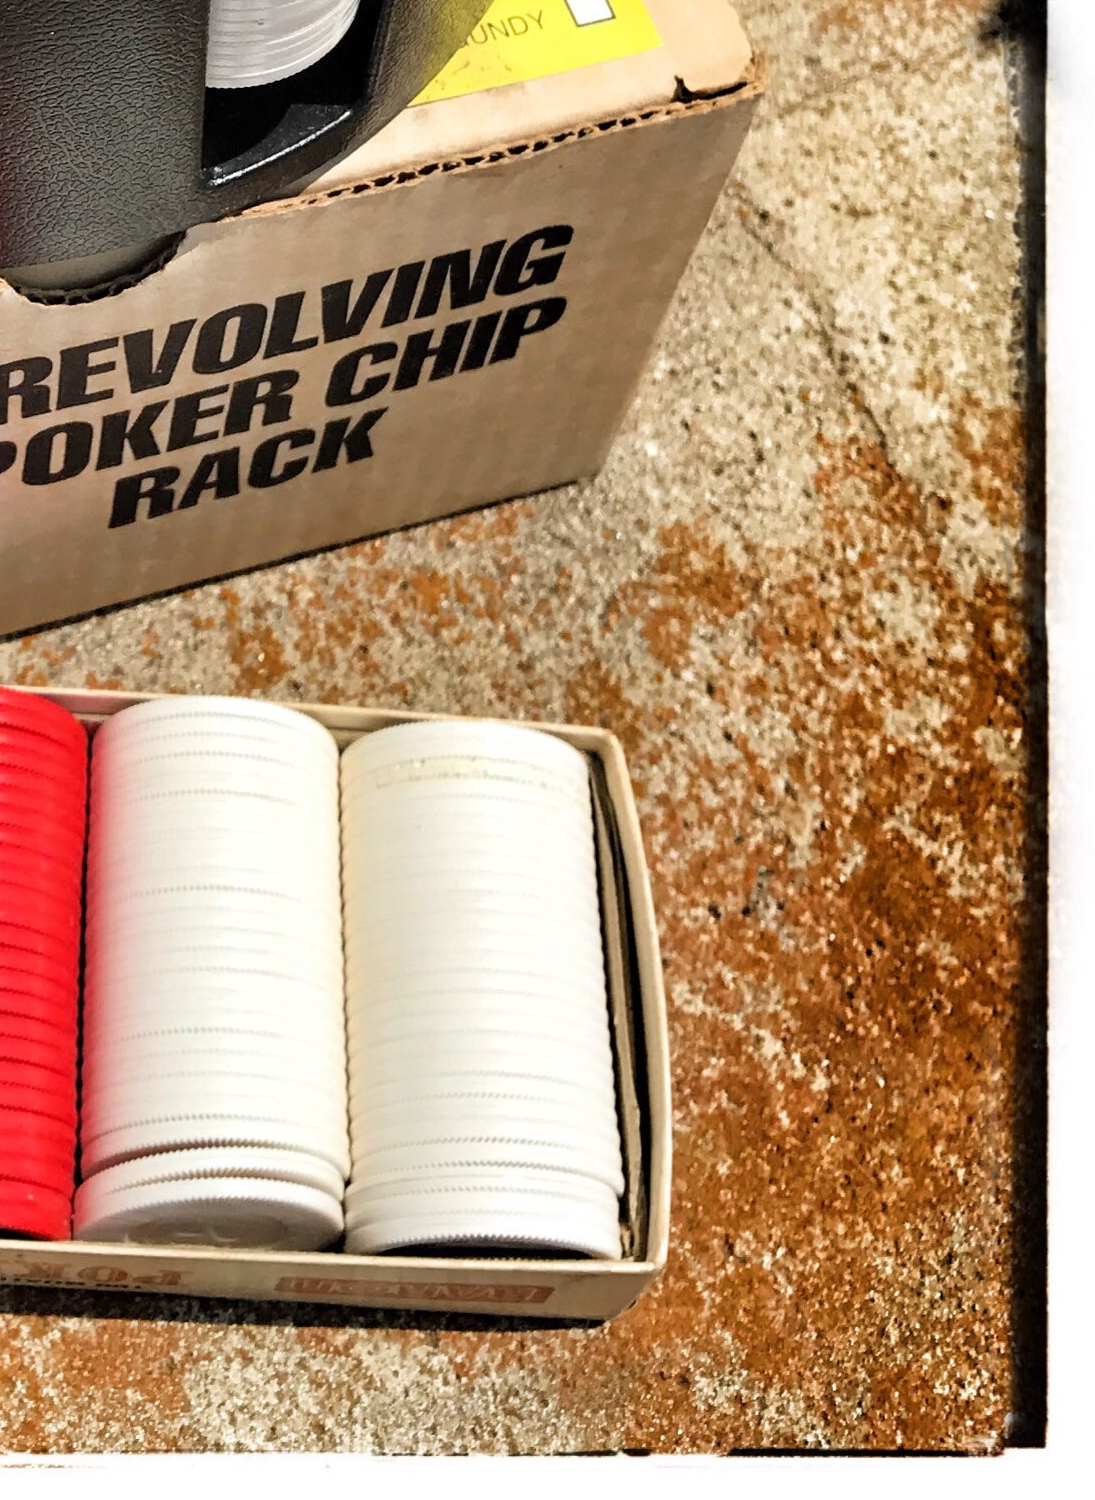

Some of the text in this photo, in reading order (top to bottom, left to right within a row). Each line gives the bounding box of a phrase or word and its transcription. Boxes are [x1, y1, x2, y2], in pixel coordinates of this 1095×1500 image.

[465, 10, 544, 46] UNDY
[324, 296, 569, 408] CHIP
[107, 407, 389, 529] RACK
